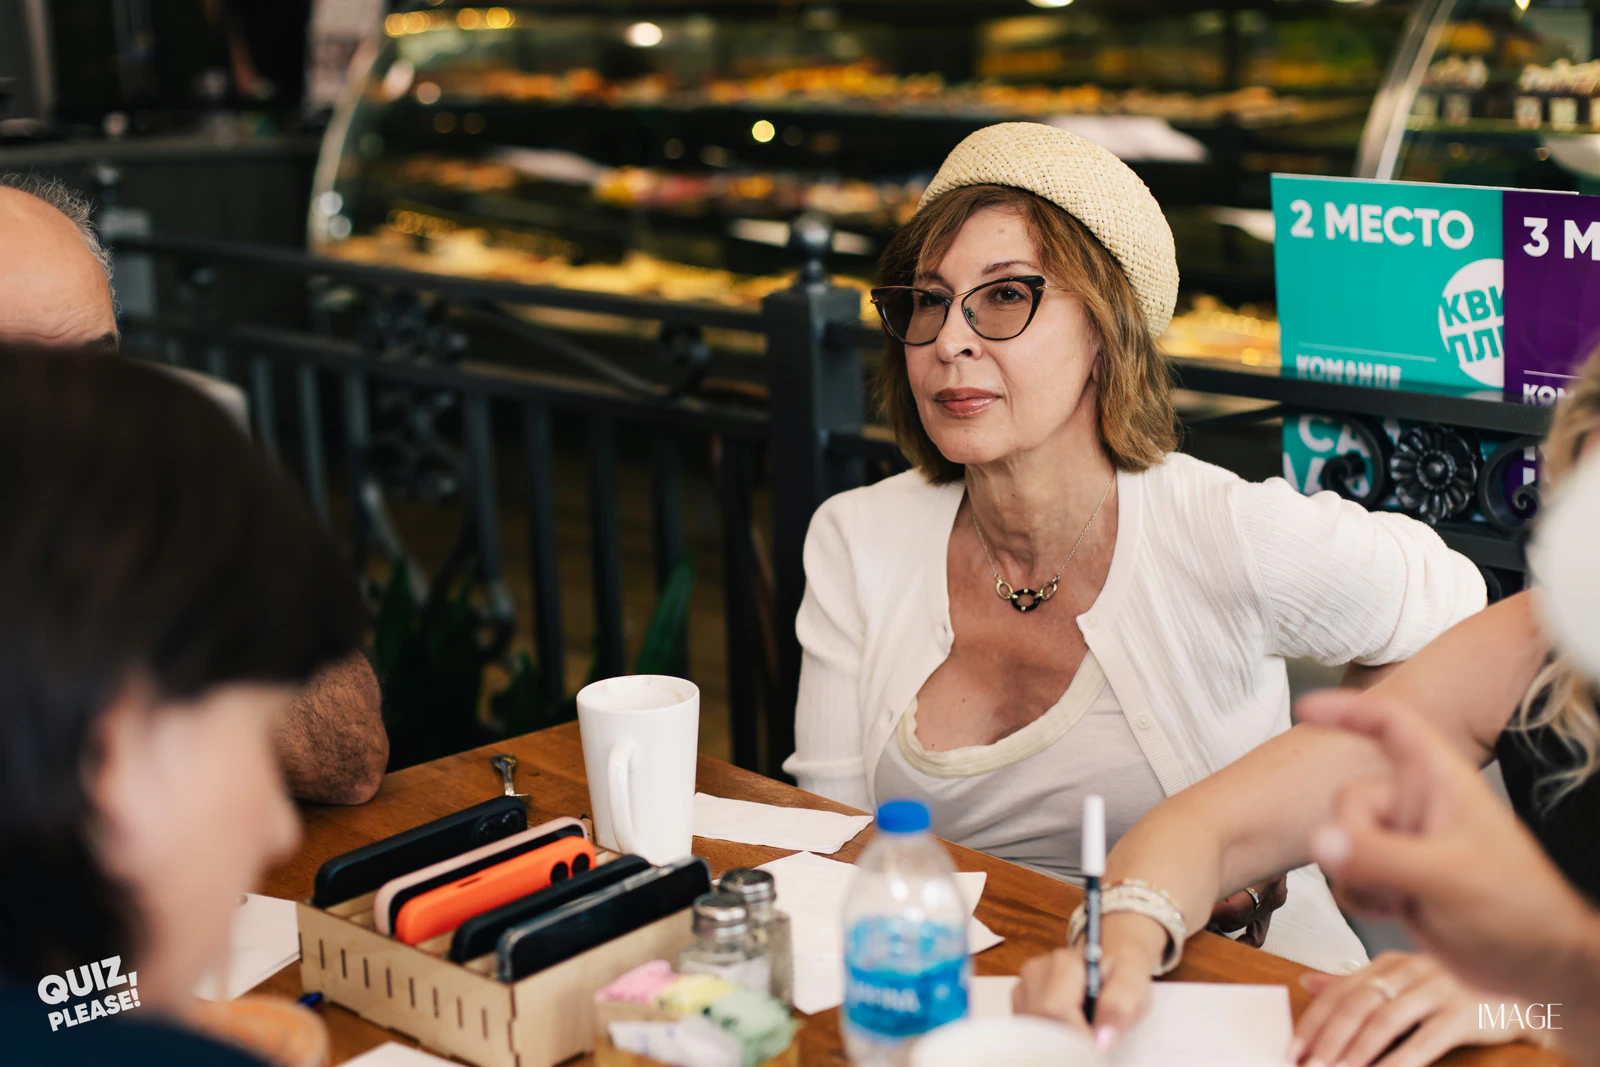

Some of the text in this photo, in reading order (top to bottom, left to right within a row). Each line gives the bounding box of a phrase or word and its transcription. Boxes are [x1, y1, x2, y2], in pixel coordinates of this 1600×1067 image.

[1290, 199, 1474, 250] 2 МЕСТО
[1523, 216, 1549, 258] 3
[1446, 325, 1504, 362] ПЛ
